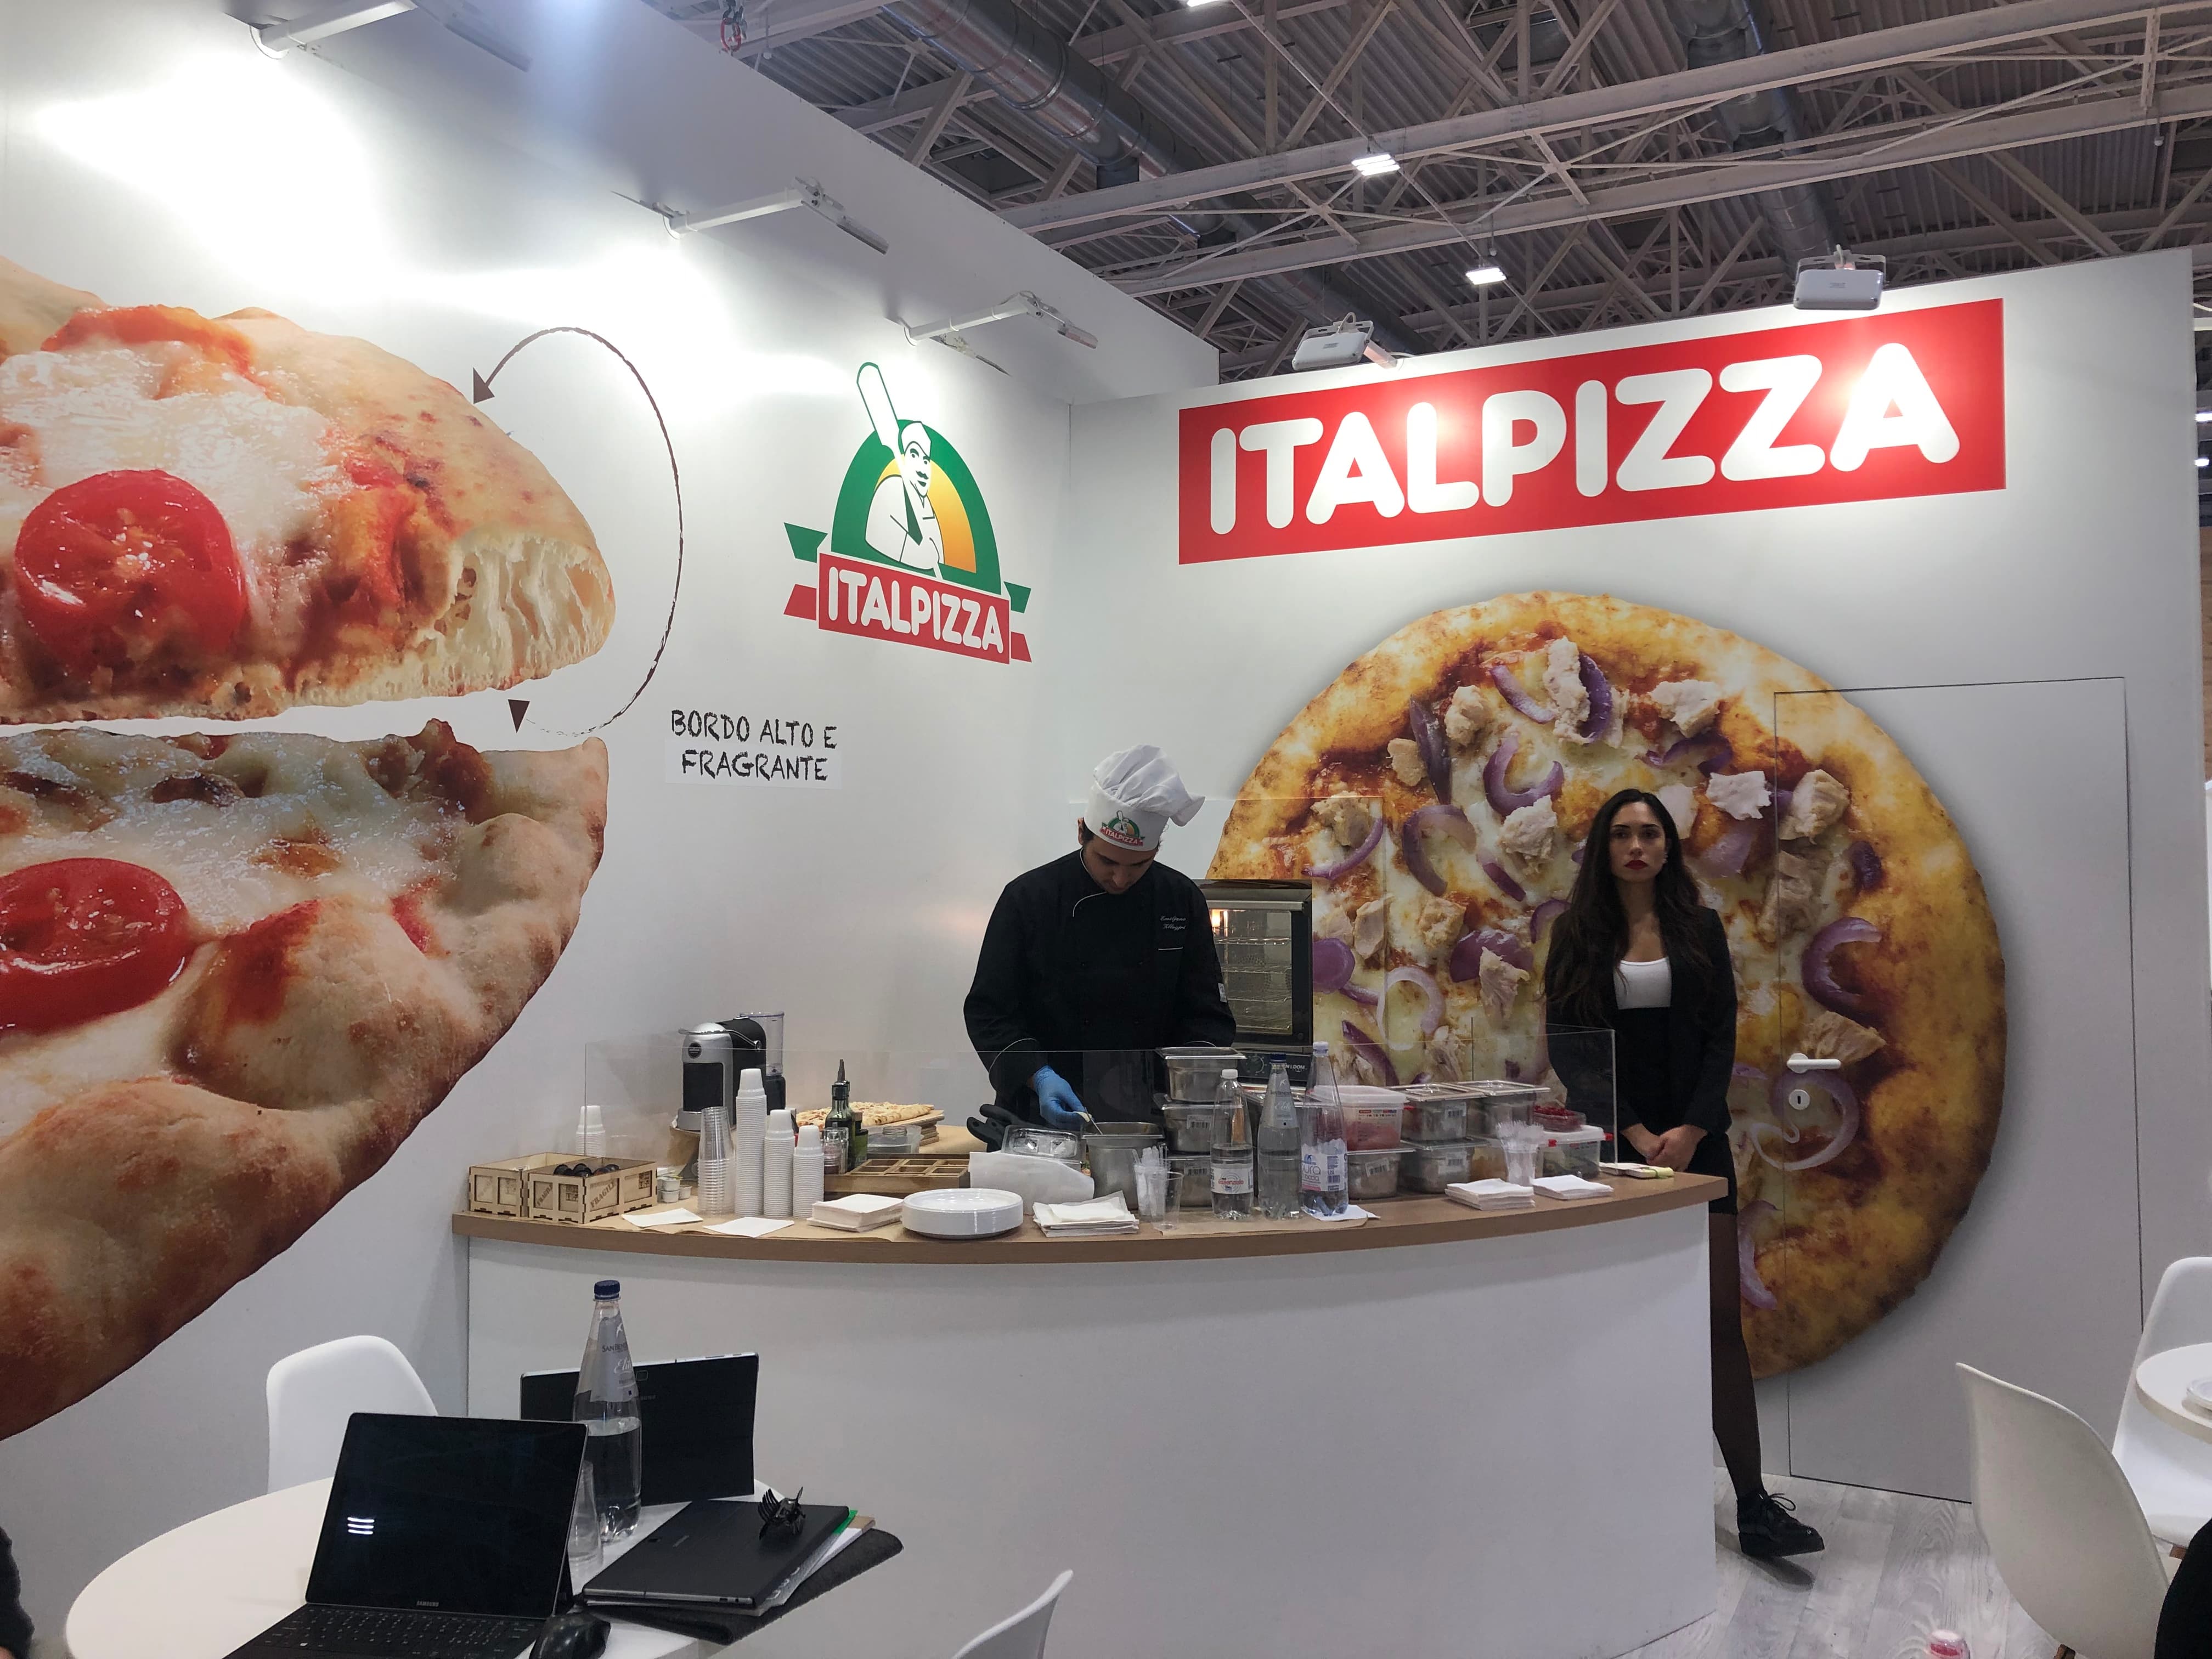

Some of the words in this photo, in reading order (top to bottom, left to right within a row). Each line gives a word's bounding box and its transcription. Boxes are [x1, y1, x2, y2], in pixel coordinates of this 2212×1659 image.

[1210, 342, 1960, 535] ITALPIZZA
[828, 566, 1004, 654] ITALPIZZA
[671, 709, 750, 742] BORDO
[759, 719, 814, 748] ALTO
[823, 726, 837, 749] E
[682, 749, 828, 781] FRAGRANTE
[1105, 828, 1138, 845] ITALPIZZA
